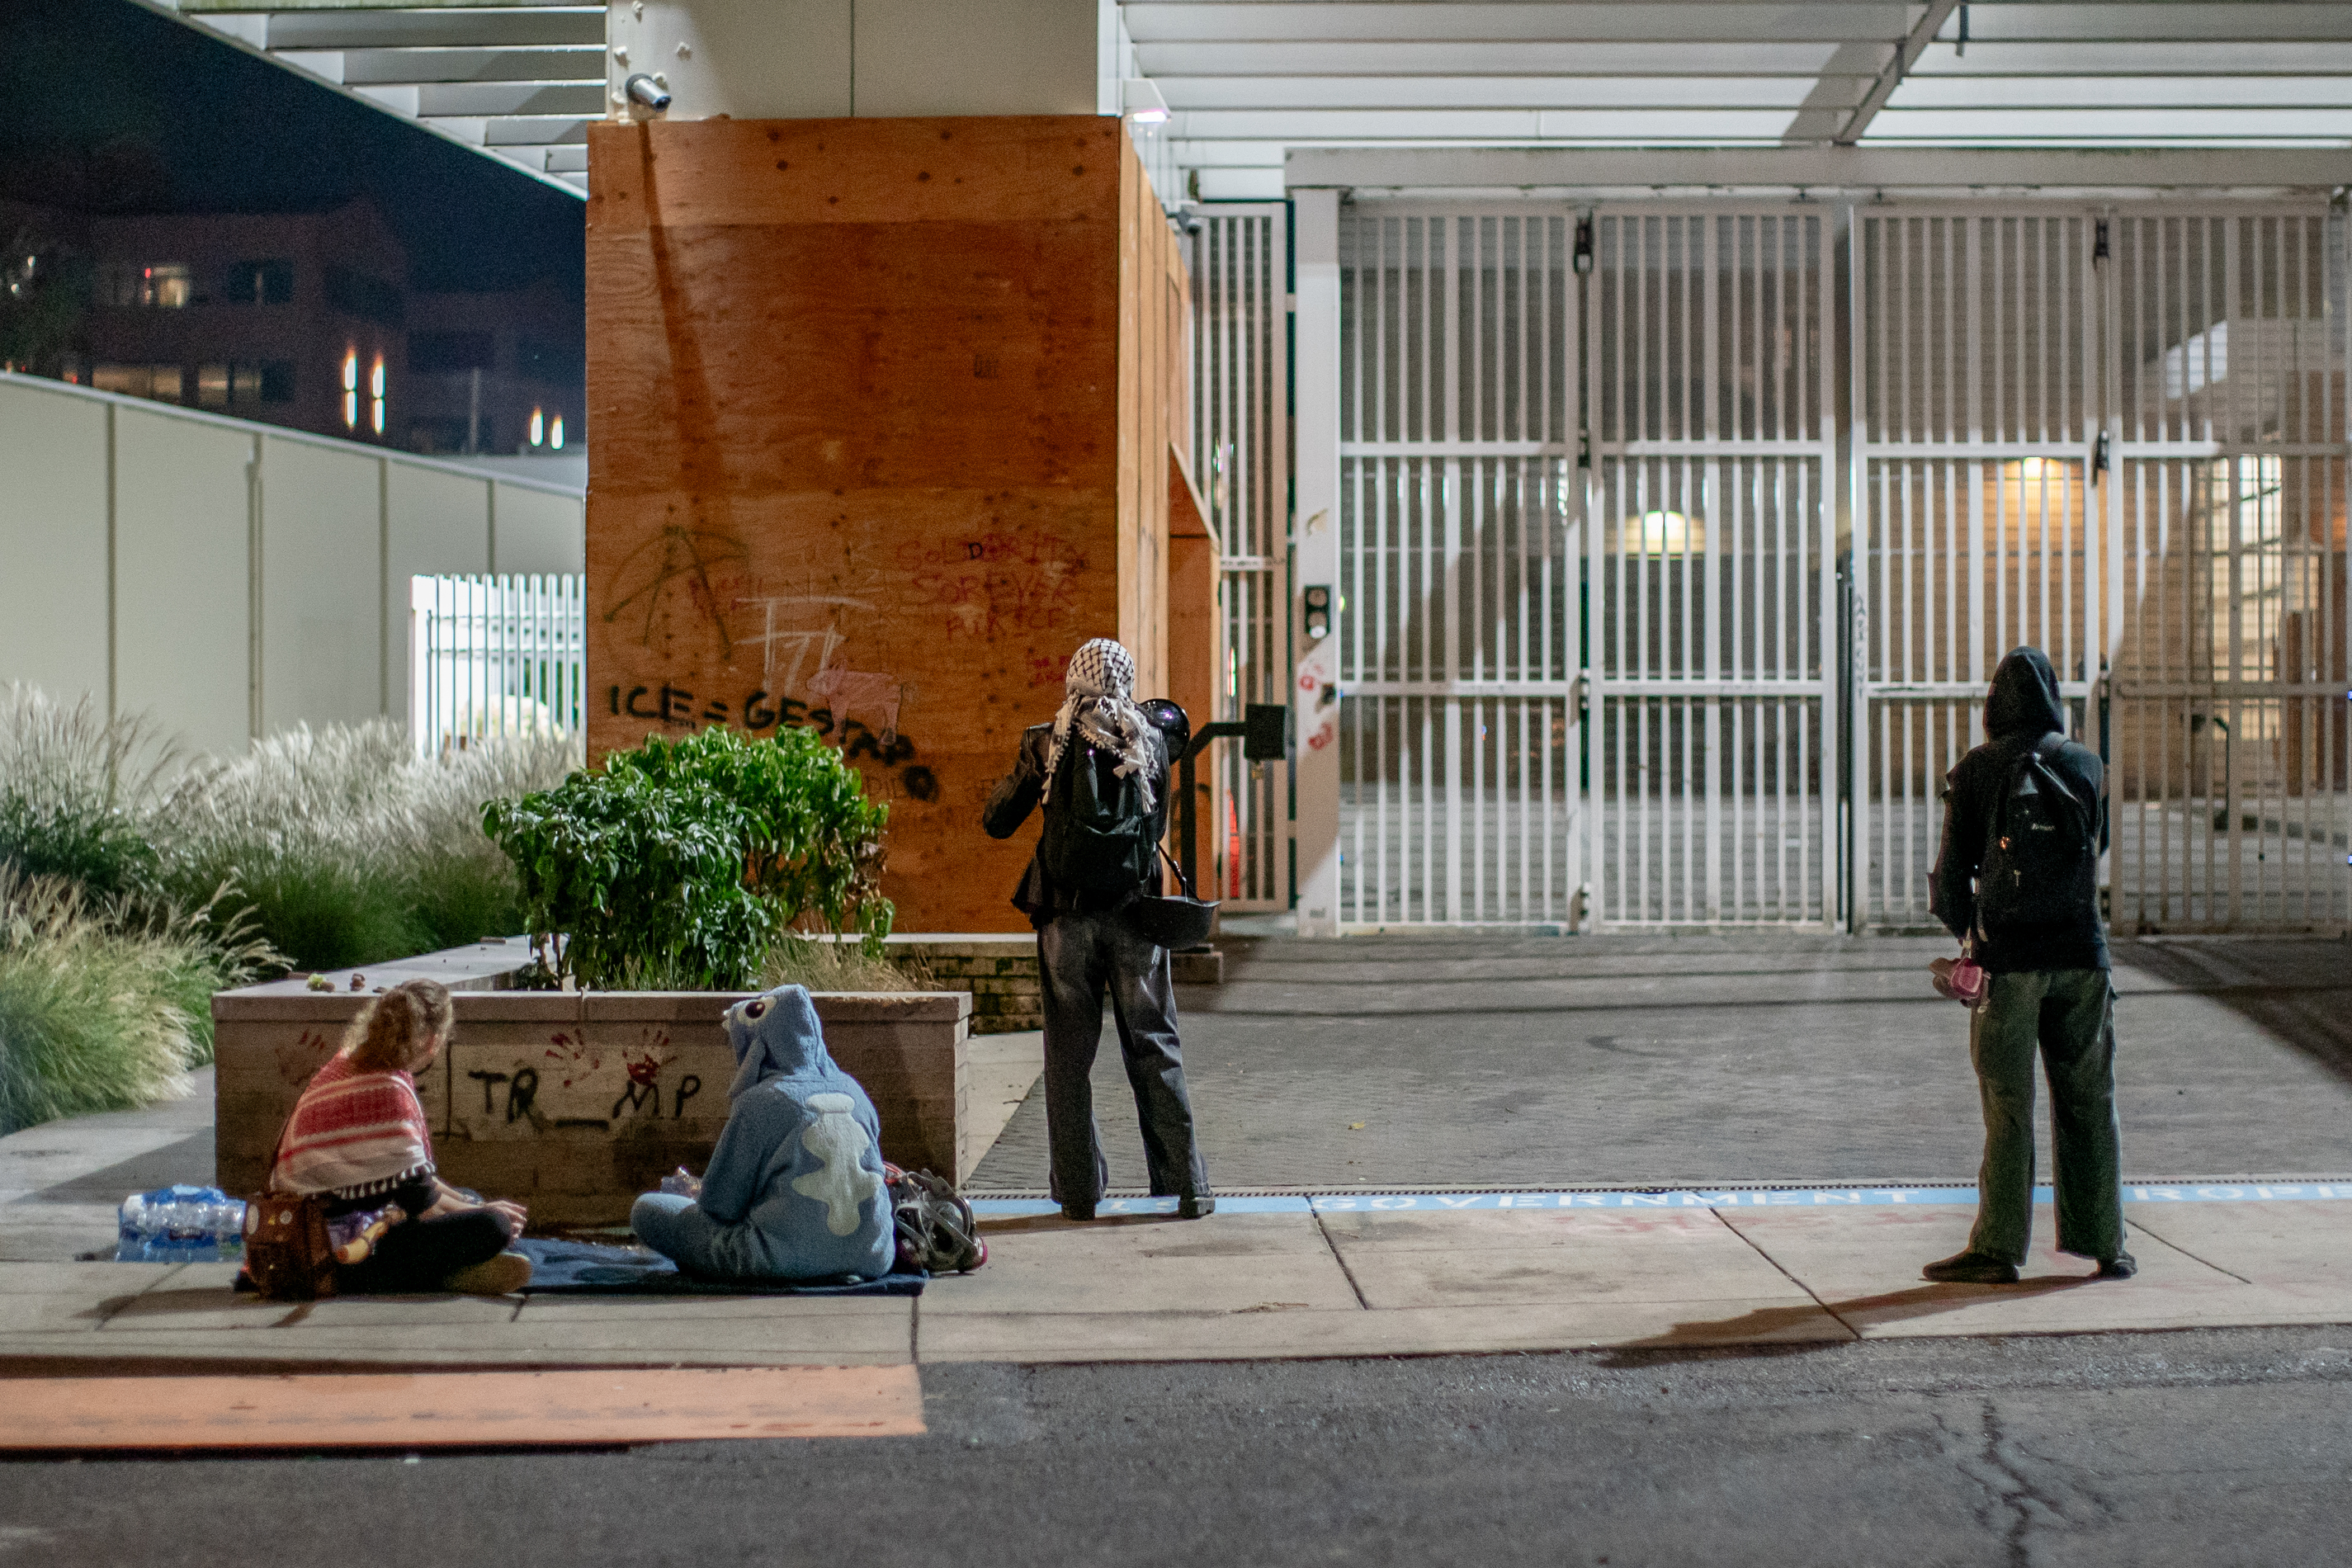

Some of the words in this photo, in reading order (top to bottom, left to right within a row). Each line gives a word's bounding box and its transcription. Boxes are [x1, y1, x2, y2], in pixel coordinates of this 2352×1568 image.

[609, 682, 693, 722] ICE
[703, 701, 728, 722] =
[1313, 1191, 1920, 1209] GOVERNMENT
[2133, 1185, 2352, 1201] ROPE
